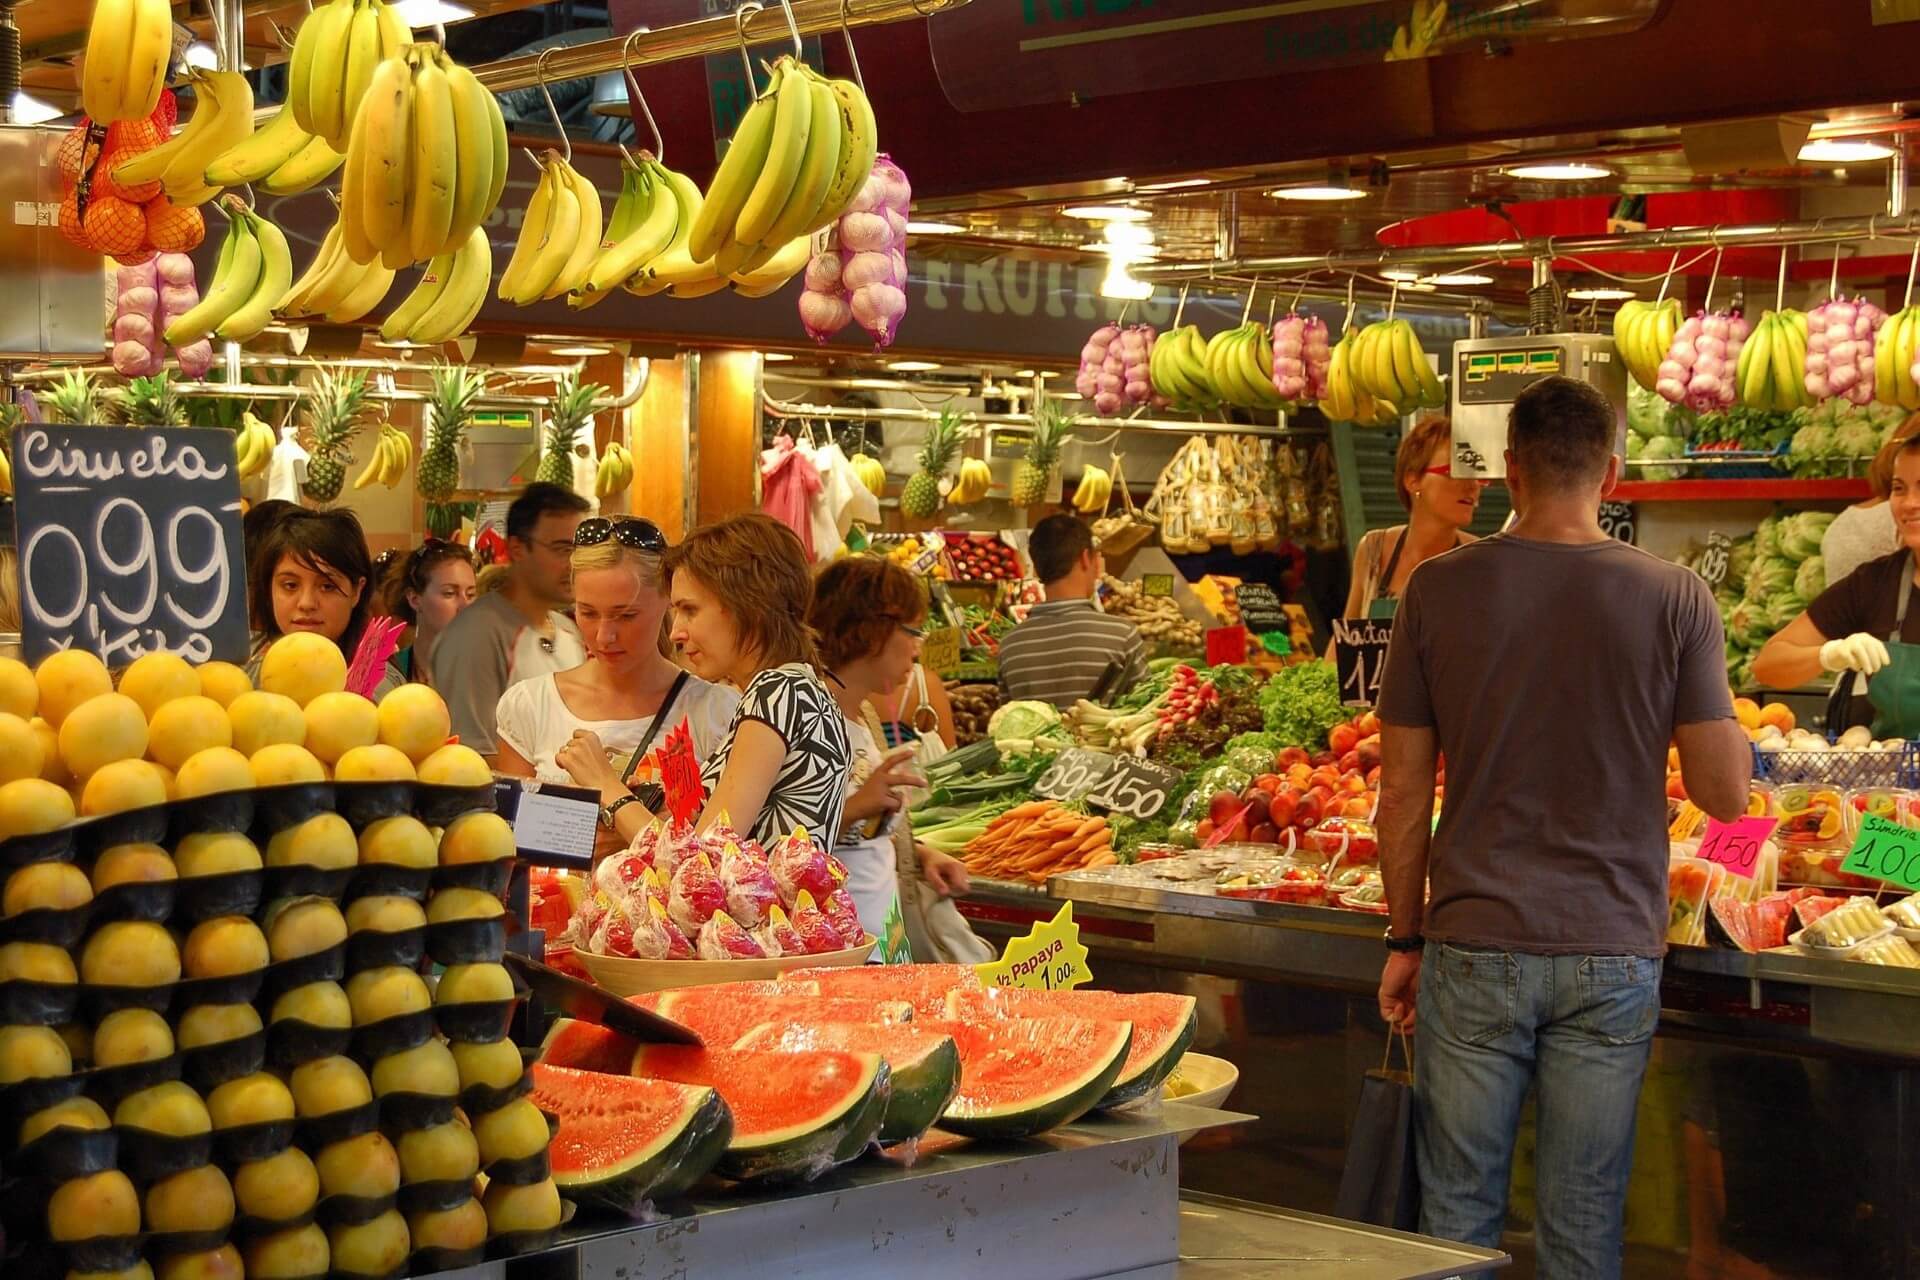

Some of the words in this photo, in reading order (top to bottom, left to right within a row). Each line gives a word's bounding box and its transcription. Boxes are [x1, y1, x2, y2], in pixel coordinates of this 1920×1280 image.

[24, 430, 228, 480] Ciruela
[24, 497, 230, 638] 0,99
[1011, 939, 1063, 981] Papaya
